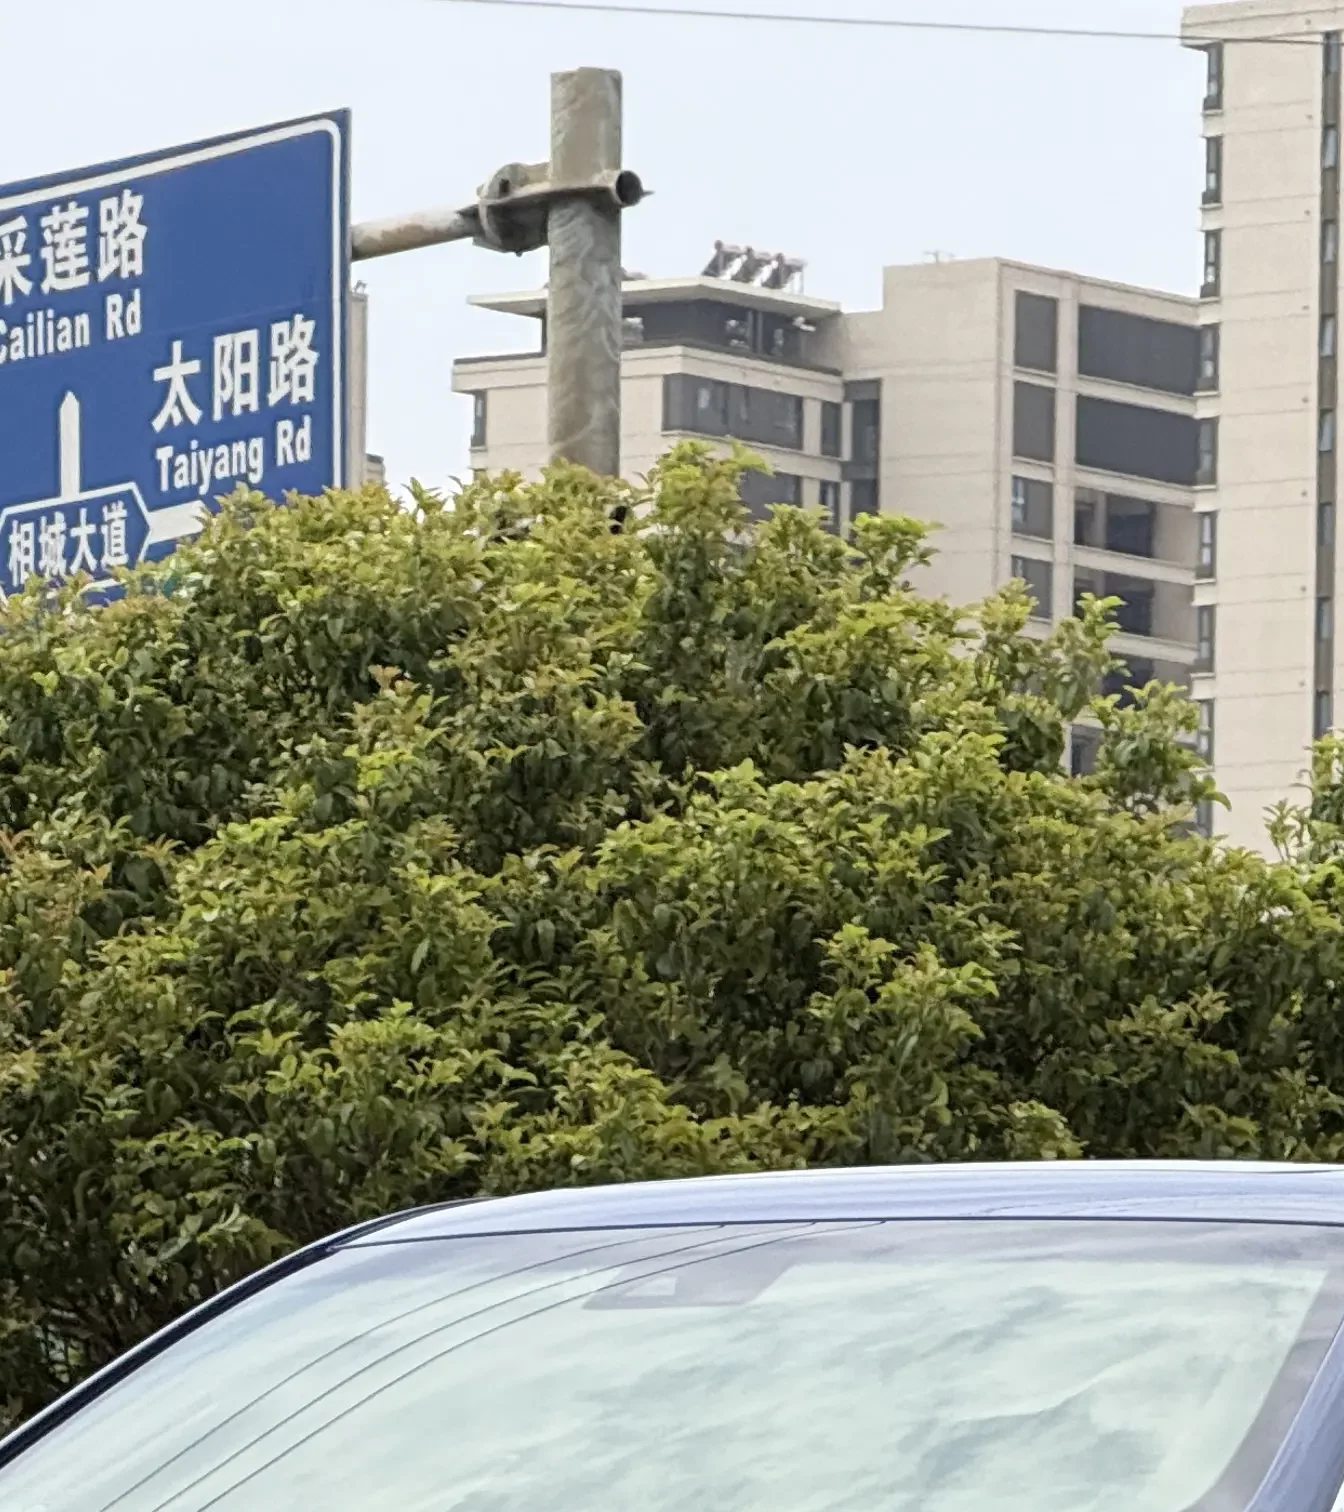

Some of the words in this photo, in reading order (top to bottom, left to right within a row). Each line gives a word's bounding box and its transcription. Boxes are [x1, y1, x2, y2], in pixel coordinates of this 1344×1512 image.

[106, 290, 142, 340] Rd
[151, 313, 320, 433] 太阳路
[156, 436, 264, 495] Taiyang
[276, 416, 312, 467] Rd
[8, 499, 129, 588] 相城大道
